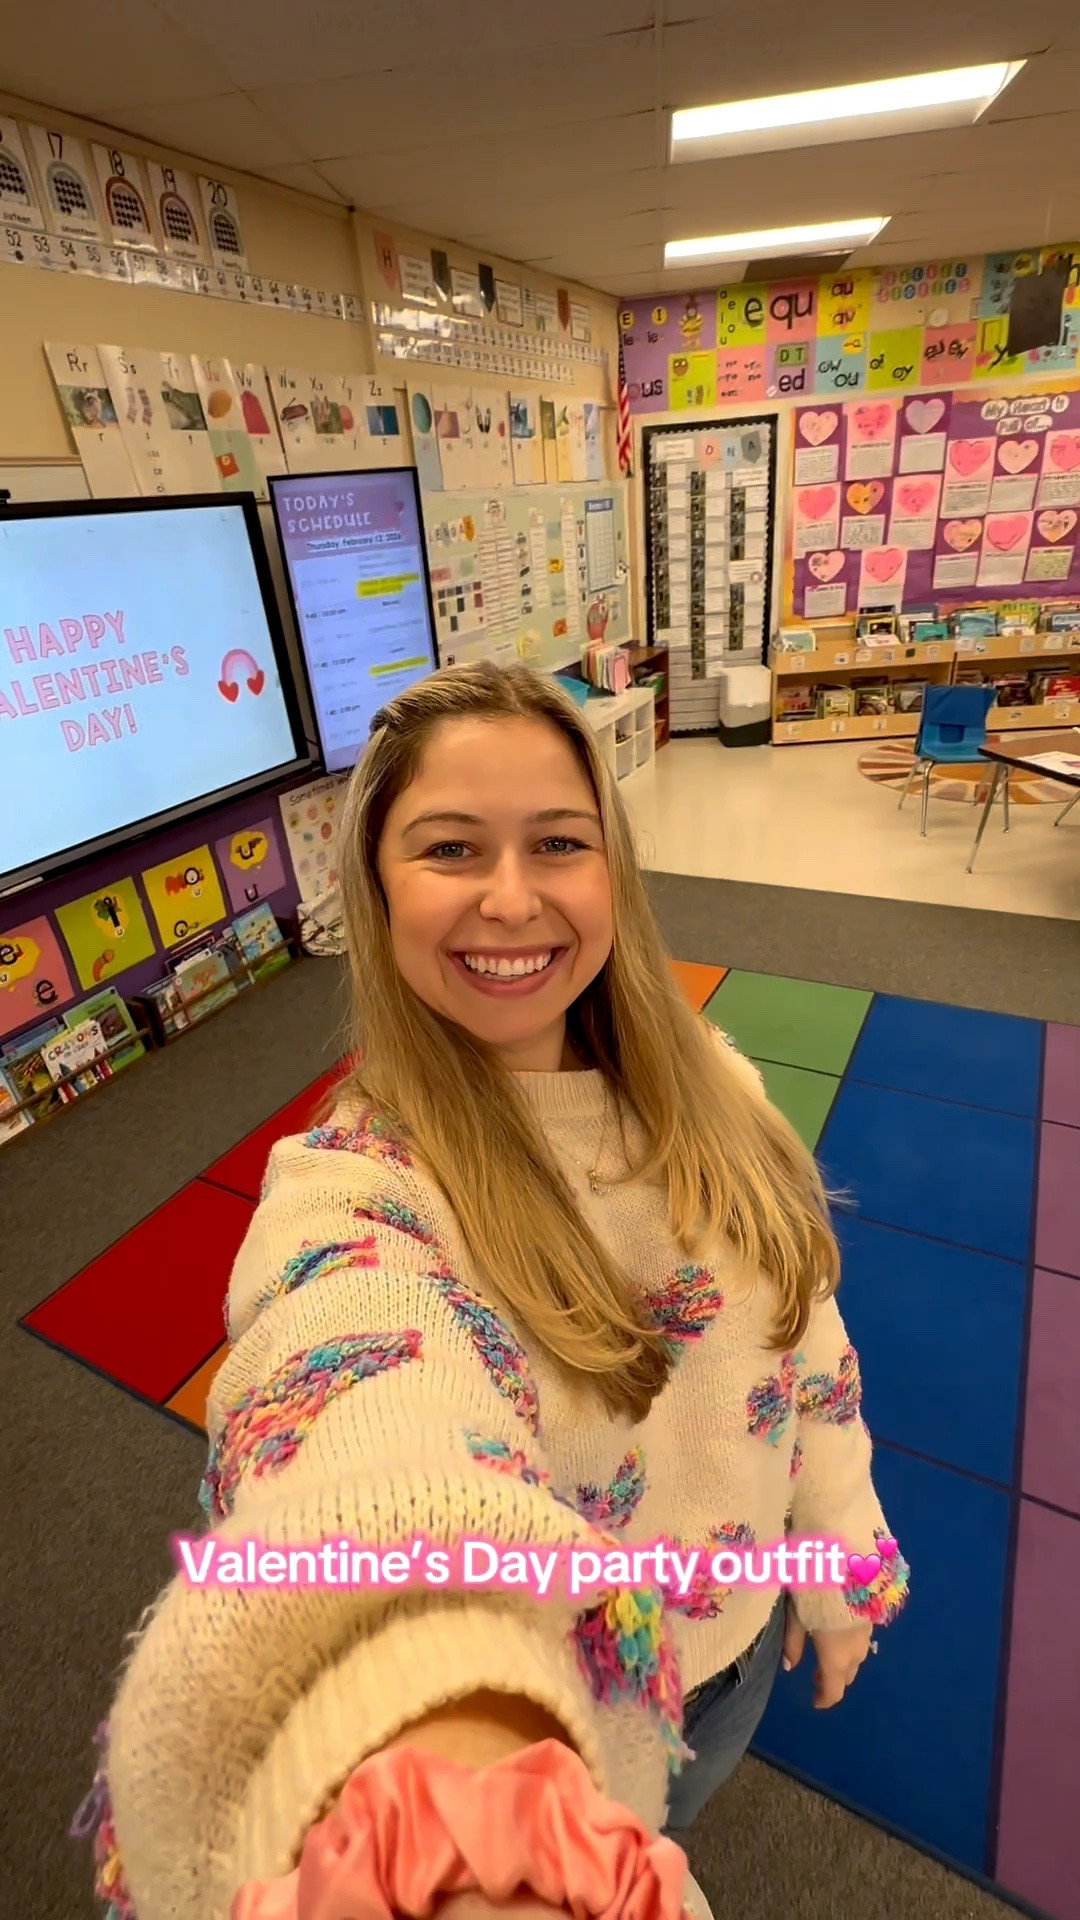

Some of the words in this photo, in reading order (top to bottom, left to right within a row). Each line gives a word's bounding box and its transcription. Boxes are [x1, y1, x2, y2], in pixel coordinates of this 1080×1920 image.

[47, 131, 62, 160] 17
[107, 149, 125, 177] 18
[161, 165, 178, 193] 19
[207, 180, 228, 207] 20
[5, 229, 22, 248] 52
[33, 235, 50, 253] 53
[60, 240, 76, 257] 54
[622, 312, 631, 326] E
[656, 308, 663, 321] I
[745, 297, 764, 327] e
[769, 291, 813, 330] qu
[66, 351, 89, 373] Rr
[779, 368, 805, 392] ed
[834, 371, 859, 388] ou
[283, 492, 355, 512] TODAY'S
[287, 512, 372, 533] SCHEDULE
[4, 609, 126, 664] HAPPY
[60, 703, 138, 752] DAY!
[244, 883, 260, 903] u
[35, 979, 58, 1005] e
